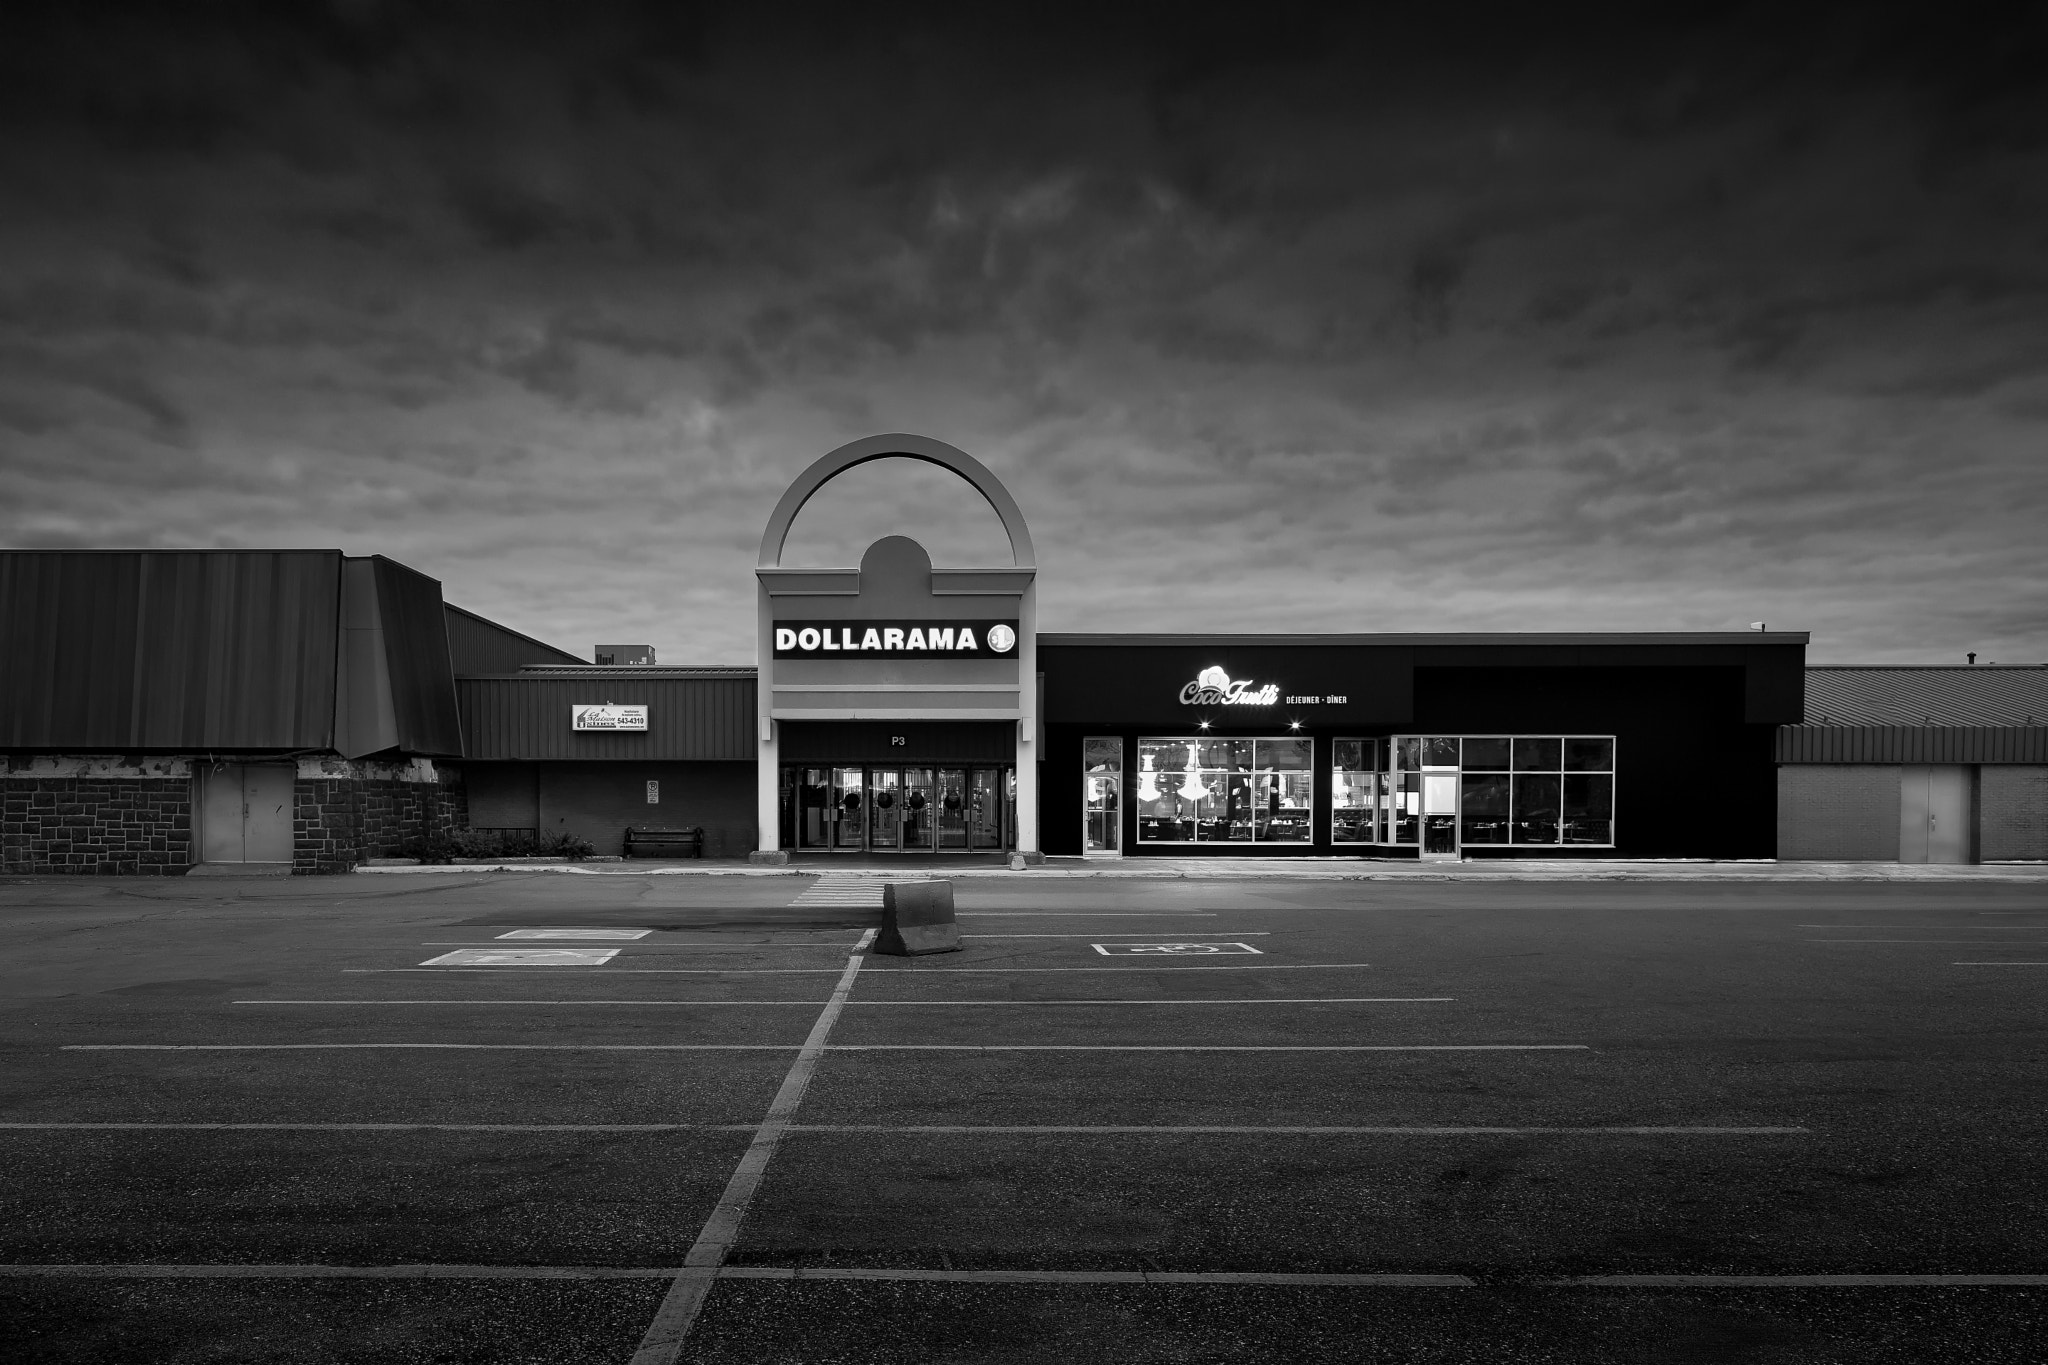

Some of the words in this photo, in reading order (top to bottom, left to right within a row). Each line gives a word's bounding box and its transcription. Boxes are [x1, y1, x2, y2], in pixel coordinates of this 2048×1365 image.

[776, 627, 978, 651] DOLLARAMA
[1286, 695, 1319, 704] DÉJEUNER
[1327, 695, 1347, 704] DÎNER
[891, 737, 905, 746] P3
